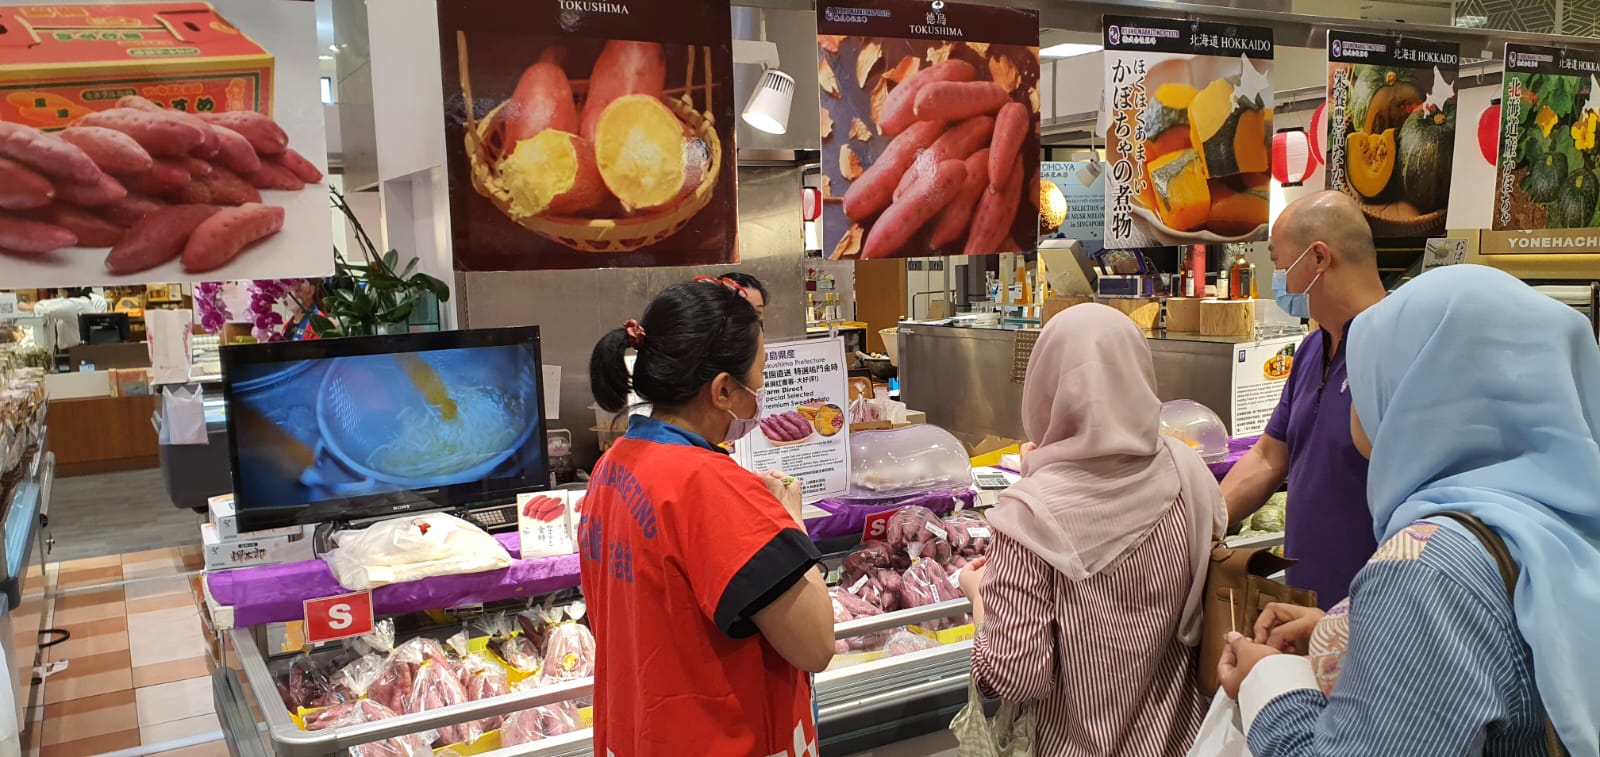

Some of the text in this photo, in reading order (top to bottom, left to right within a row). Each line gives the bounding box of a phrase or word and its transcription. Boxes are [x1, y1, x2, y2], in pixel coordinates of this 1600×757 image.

[559, 0, 629, 14] TOKUSHIMA
[909, 25, 963, 36] TOKUSHIMA
[1190, 34, 1271, 51] 北海道 HOKKAIDO
[1393, 48, 1457, 64] 北海道 HOKKAIDO
[1559, 58, 1578, 70] 北海道
[1112, 58, 1133, 239] かぼちゃの煮物
[1040, 163, 1075, 171] OHO-YA
[795, 357, 826, 365] Prefecture
[782, 385, 803, 393] Direct
[787, 391, 814, 399] Selected
[601, 460, 658, 539] MARKETING
[869, 519, 885, 536] S
[327, 603, 353, 630] S
